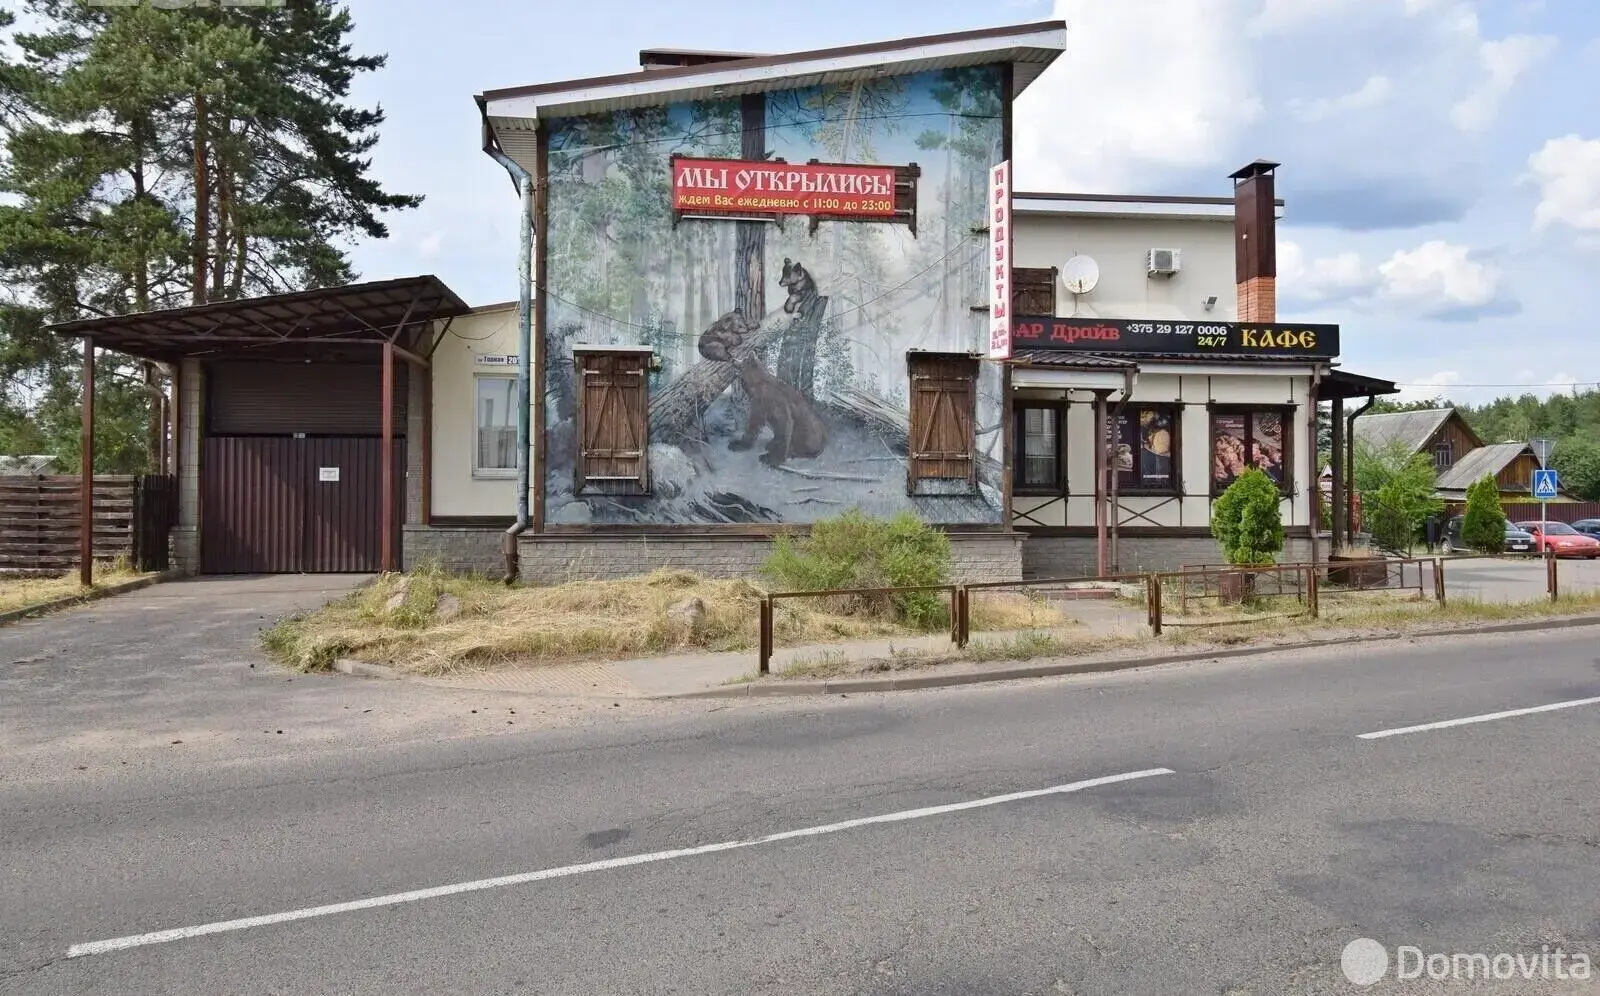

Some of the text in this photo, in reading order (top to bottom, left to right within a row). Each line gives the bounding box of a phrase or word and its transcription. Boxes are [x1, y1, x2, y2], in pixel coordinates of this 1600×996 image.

[677, 167, 892, 195] МЫ ОТКРЫЛИСЬ!
[679, 195, 892, 211] ждем Вас ежедневно с 11:00 до 23:00
[993, 168, 1006, 319] ПРОДУКТЫ
[1013, 323, 1044, 339] АР
[1050, 323, 1120, 344] Драйв
[1127, 323, 1228, 336] +375 29 127 0006
[1241, 328, 1316, 349] КАФЕ
[1197, 336, 1228, 348] 24/7
